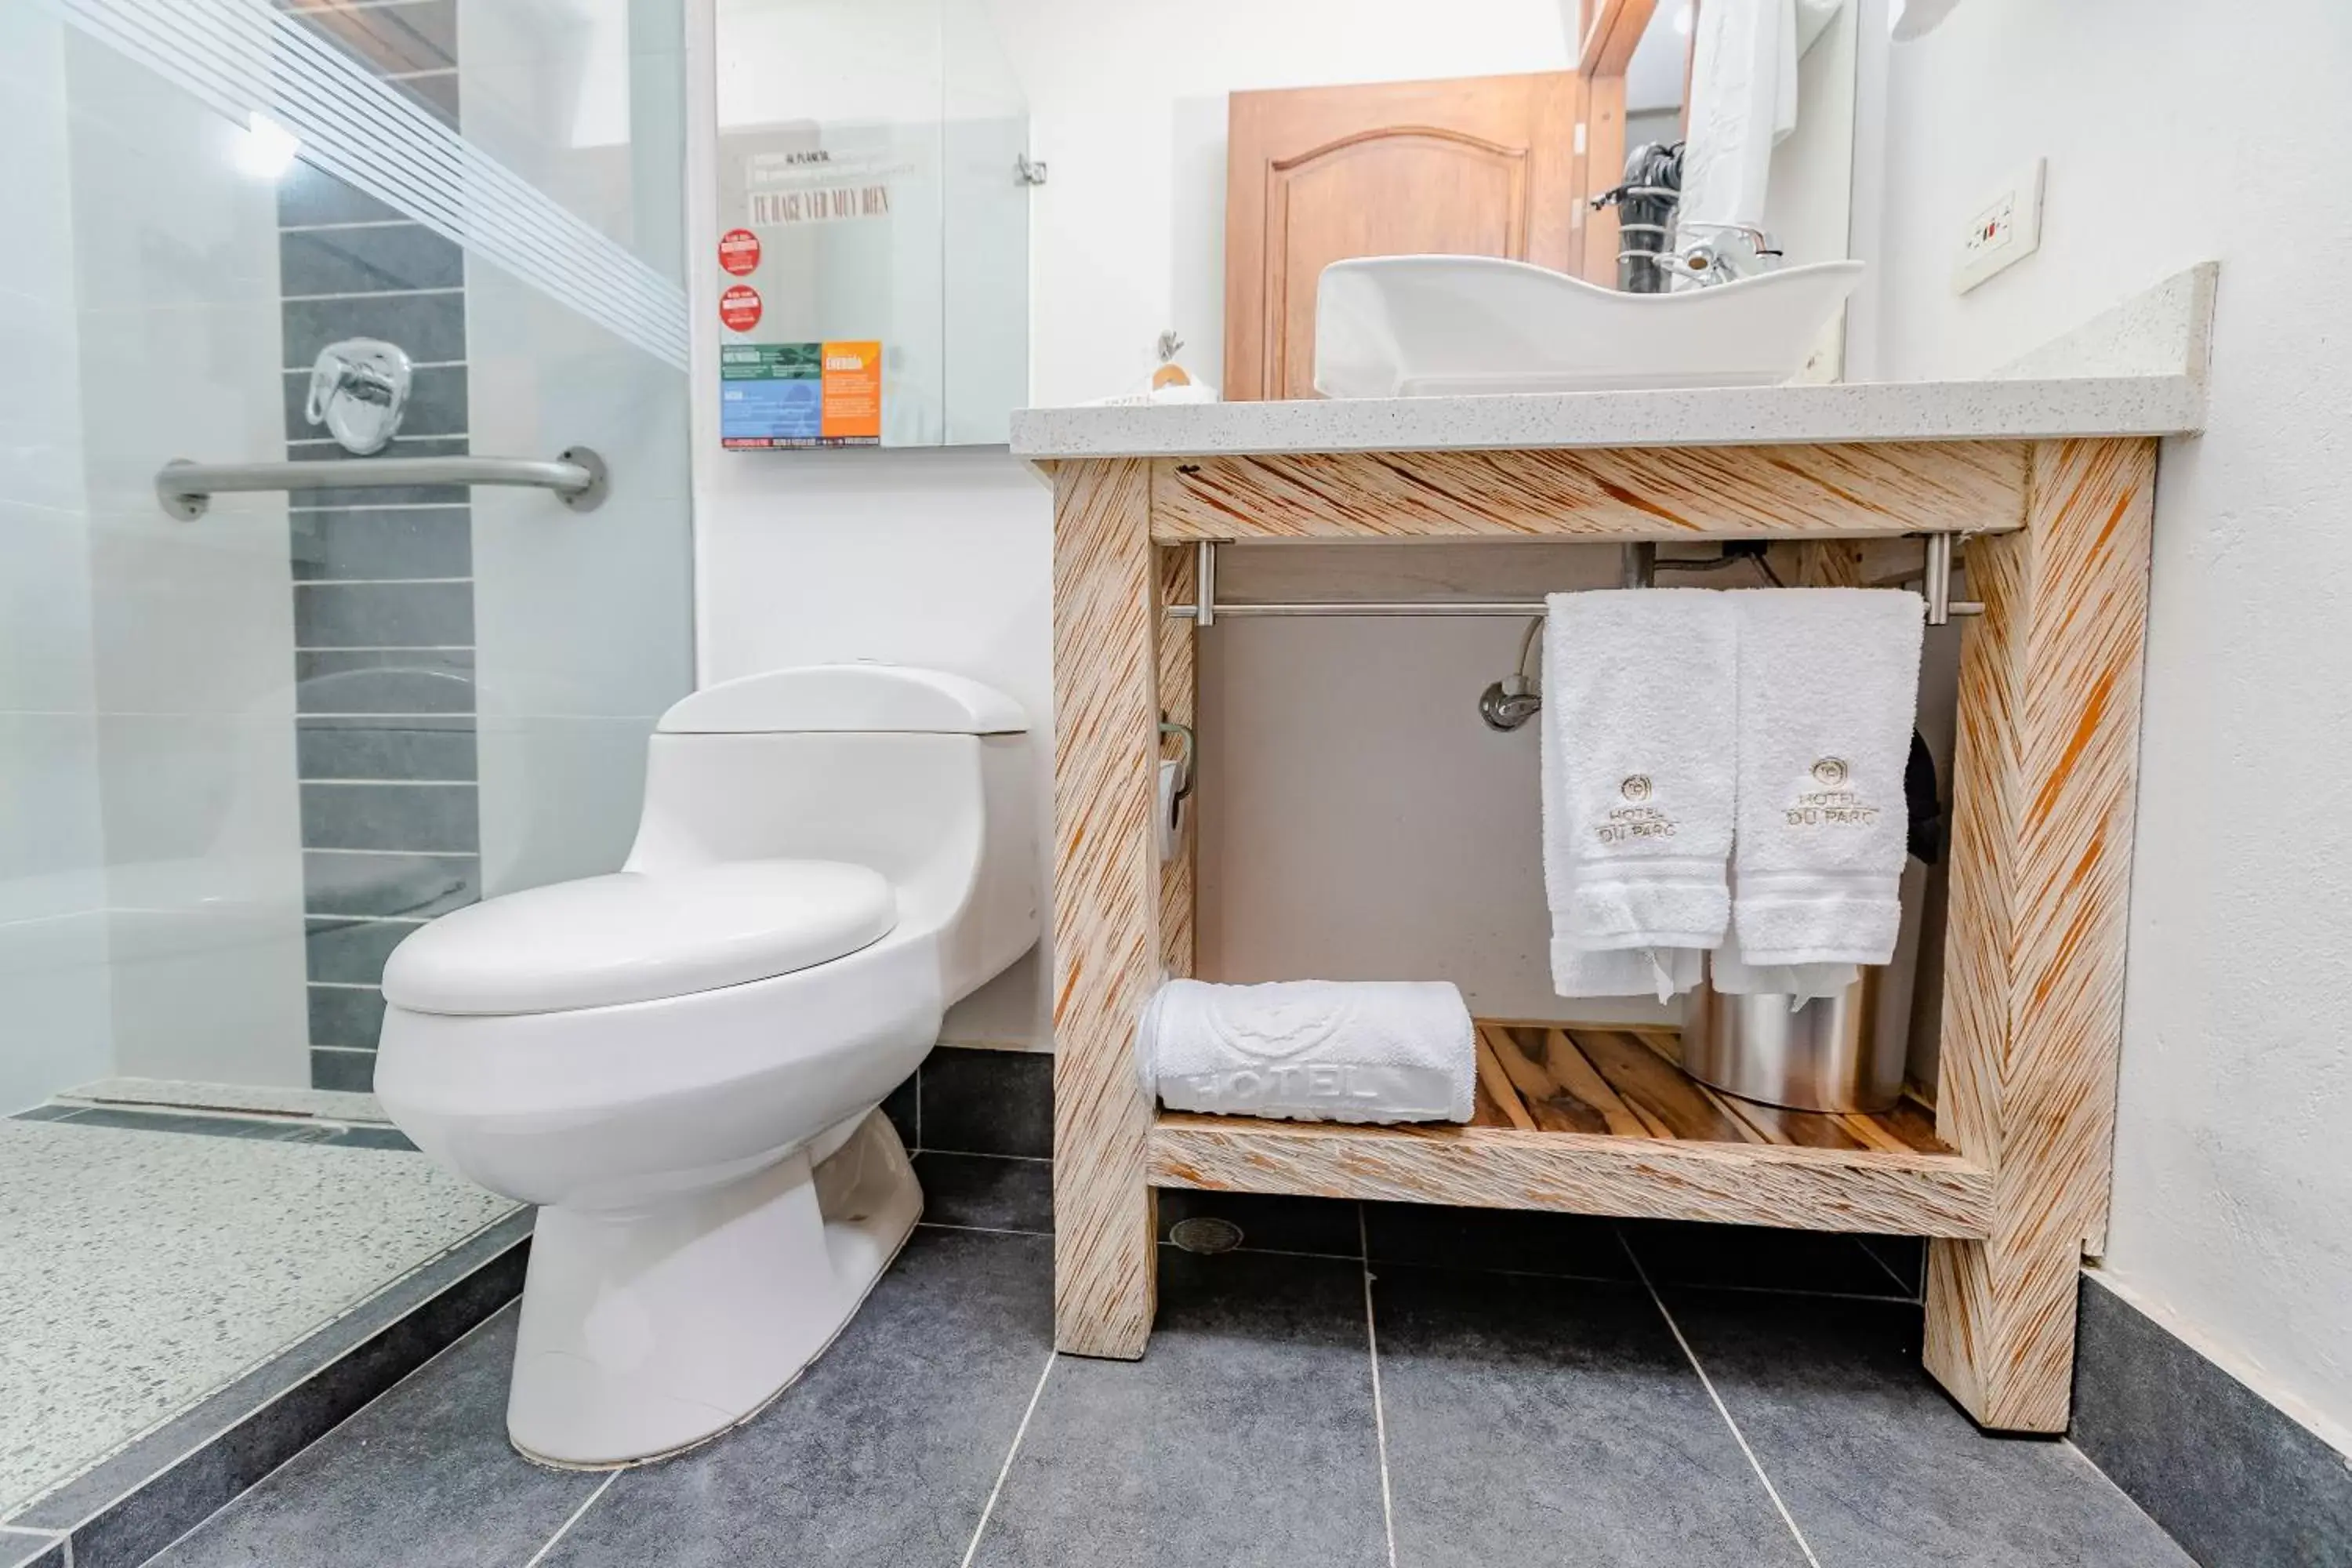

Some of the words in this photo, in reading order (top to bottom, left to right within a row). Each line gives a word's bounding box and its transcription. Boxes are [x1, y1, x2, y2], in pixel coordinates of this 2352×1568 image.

[1798, 792, 1861, 806] HOTEL
[1610, 808, 1664, 820] HOTEL
[1786, 809, 1817, 826] DU
[1824, 808, 1873, 826] PARC
[1599, 826, 1625, 843] DU
[1632, 823, 1676, 838] PARC
[1186, 1063, 1378, 1101] HOTEL
